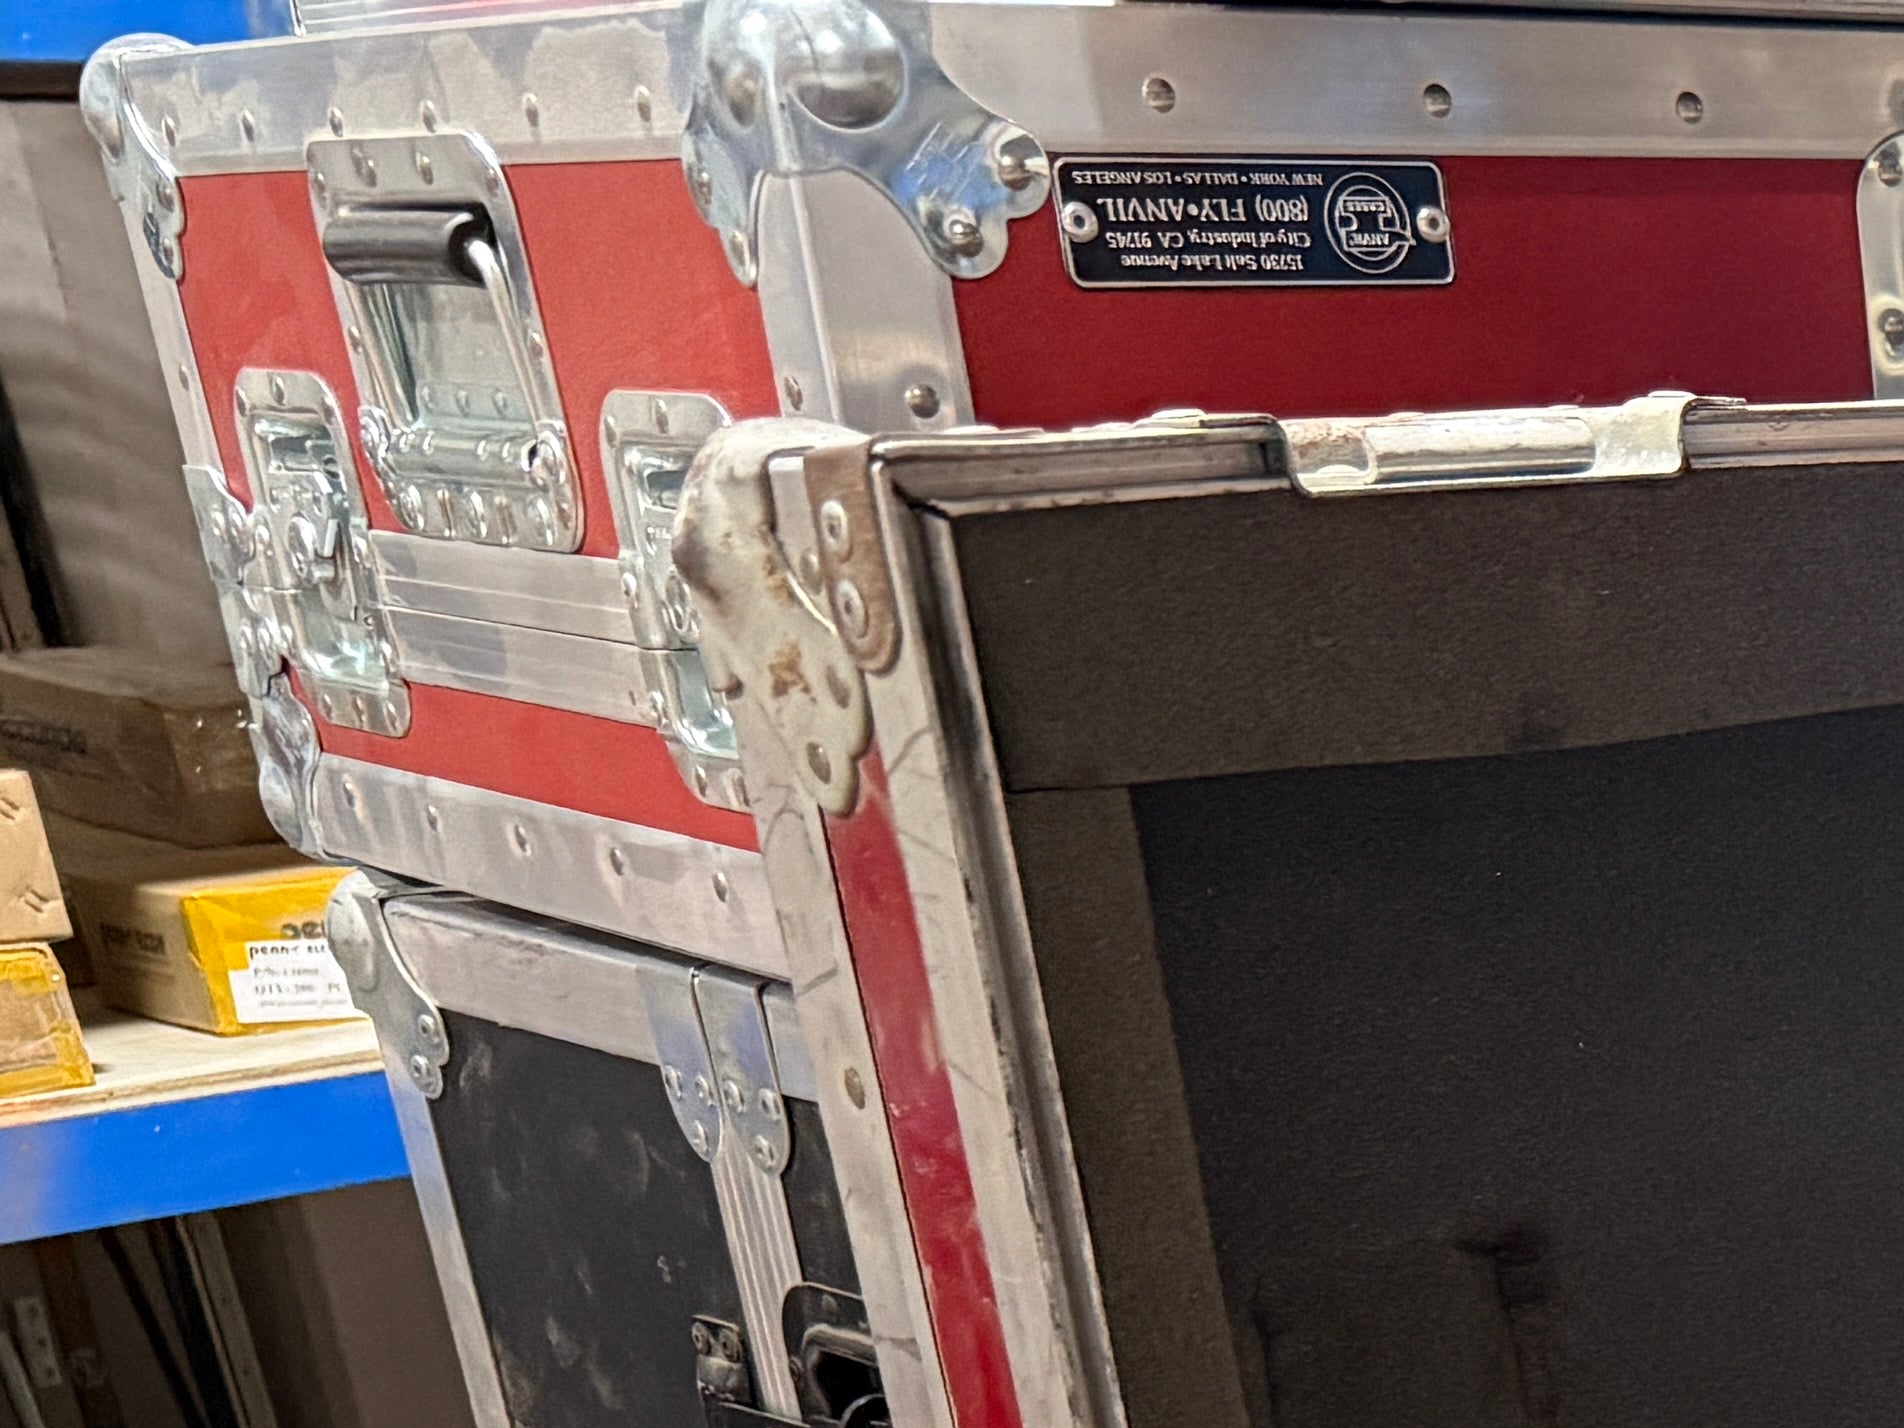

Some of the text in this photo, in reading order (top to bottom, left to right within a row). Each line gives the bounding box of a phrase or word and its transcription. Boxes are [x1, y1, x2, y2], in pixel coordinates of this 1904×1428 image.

[1071, 171, 1324, 186] NEW YORK DALLAS LOS ANGELES
[1255, 194, 1309, 222] (800)
[1105, 232, 1152, 248] 91745
[1158, 232, 1184, 248] CA
[1276, 229, 1311, 248] City
[1121, 254, 1304, 270] 15730 Salt Lake Avenue
